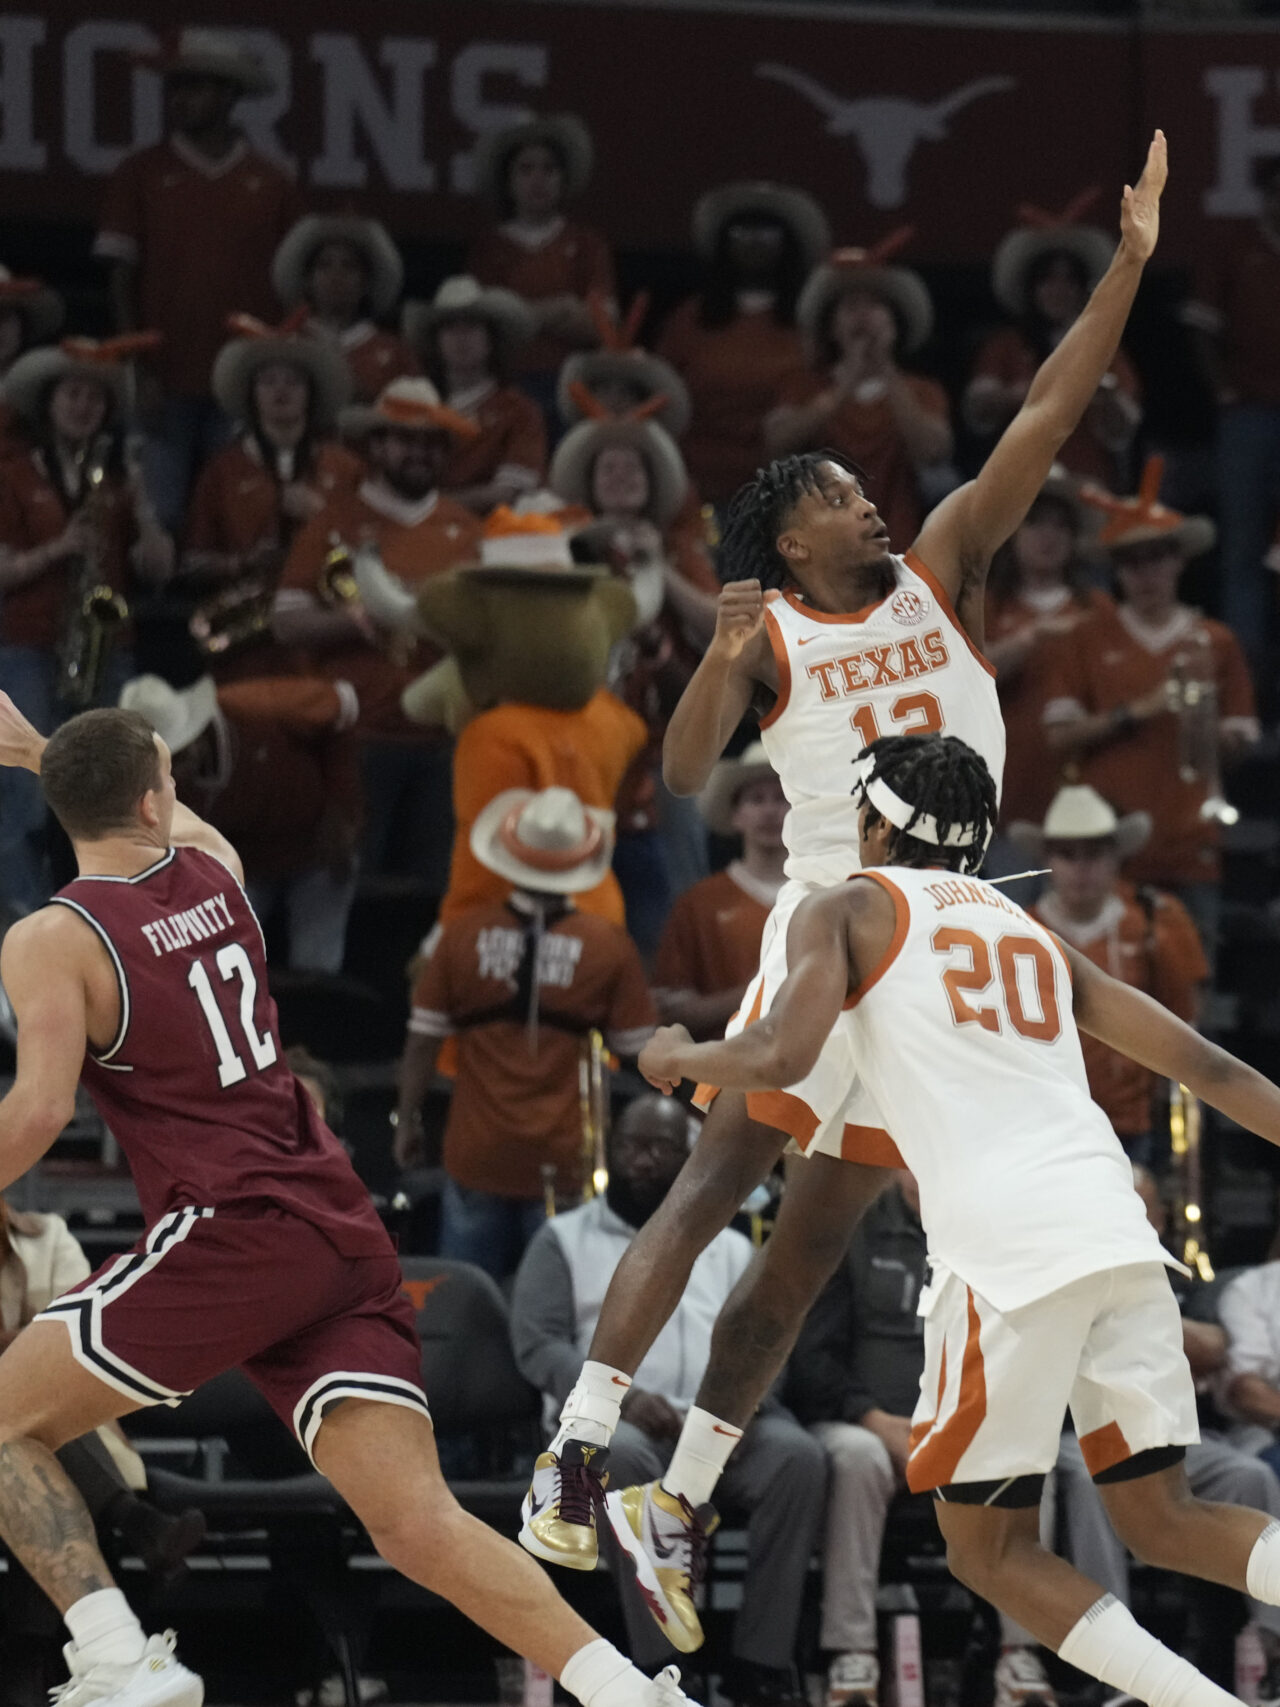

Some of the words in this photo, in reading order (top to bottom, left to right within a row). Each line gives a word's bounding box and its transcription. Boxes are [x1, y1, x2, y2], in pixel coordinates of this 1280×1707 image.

[892, 591, 920, 618] SEC
[808, 631, 950, 701] TEXAS
[187, 942, 277, 1088] 12
[930, 925, 1063, 1044] 20
